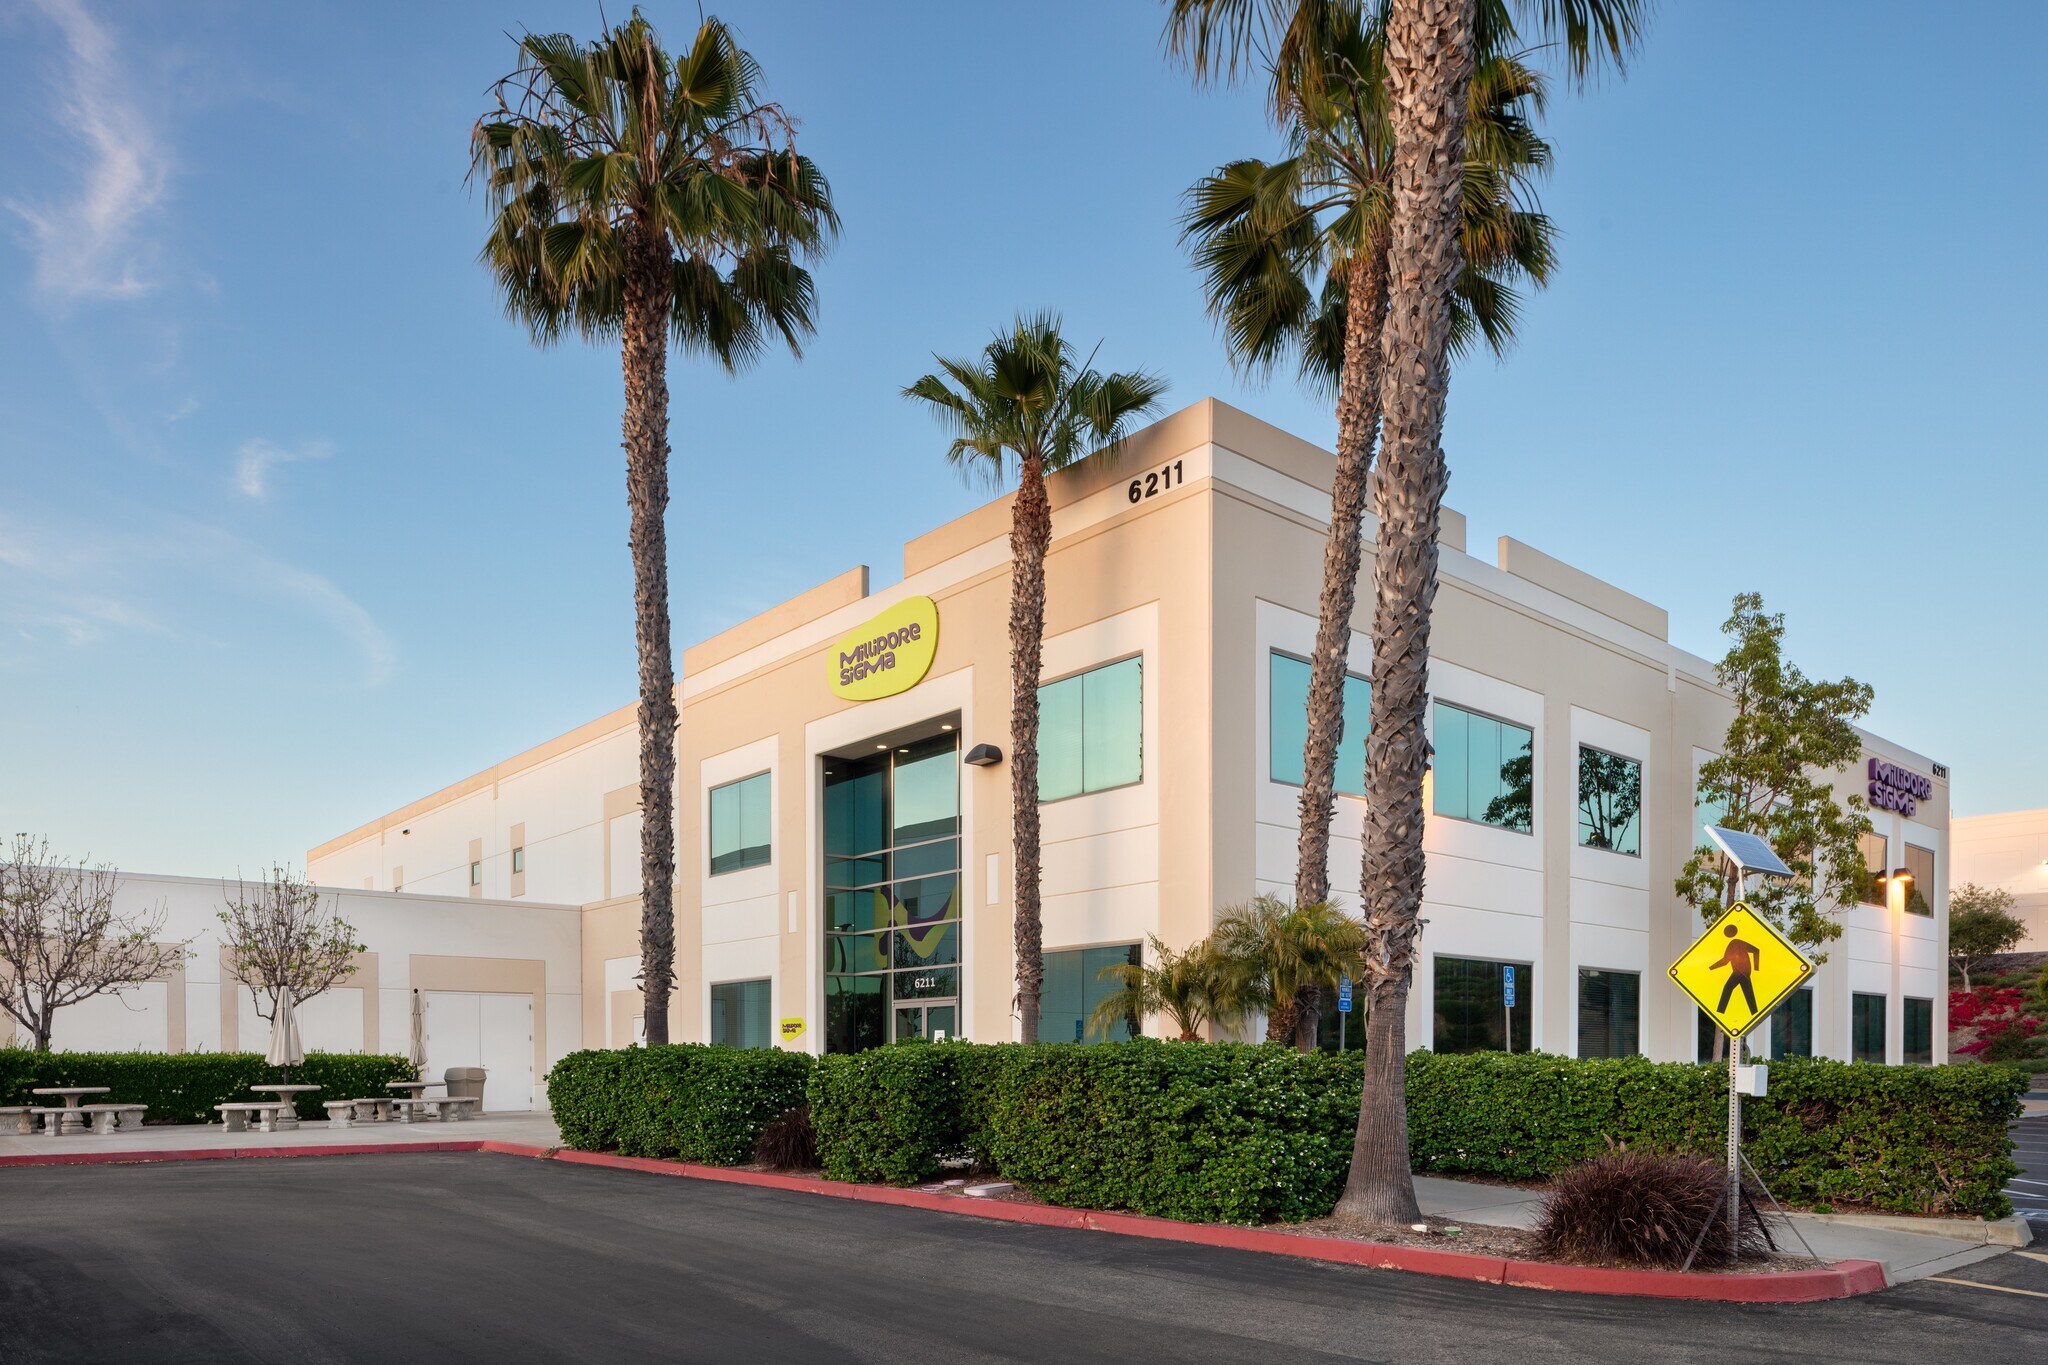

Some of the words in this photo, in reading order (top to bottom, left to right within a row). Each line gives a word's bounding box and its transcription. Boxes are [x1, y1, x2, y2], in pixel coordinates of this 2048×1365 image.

[1128, 460, 1182, 503] 6211
[1932, 763, 1946, 778] 6211
[915, 977, 935, 988] 6211
